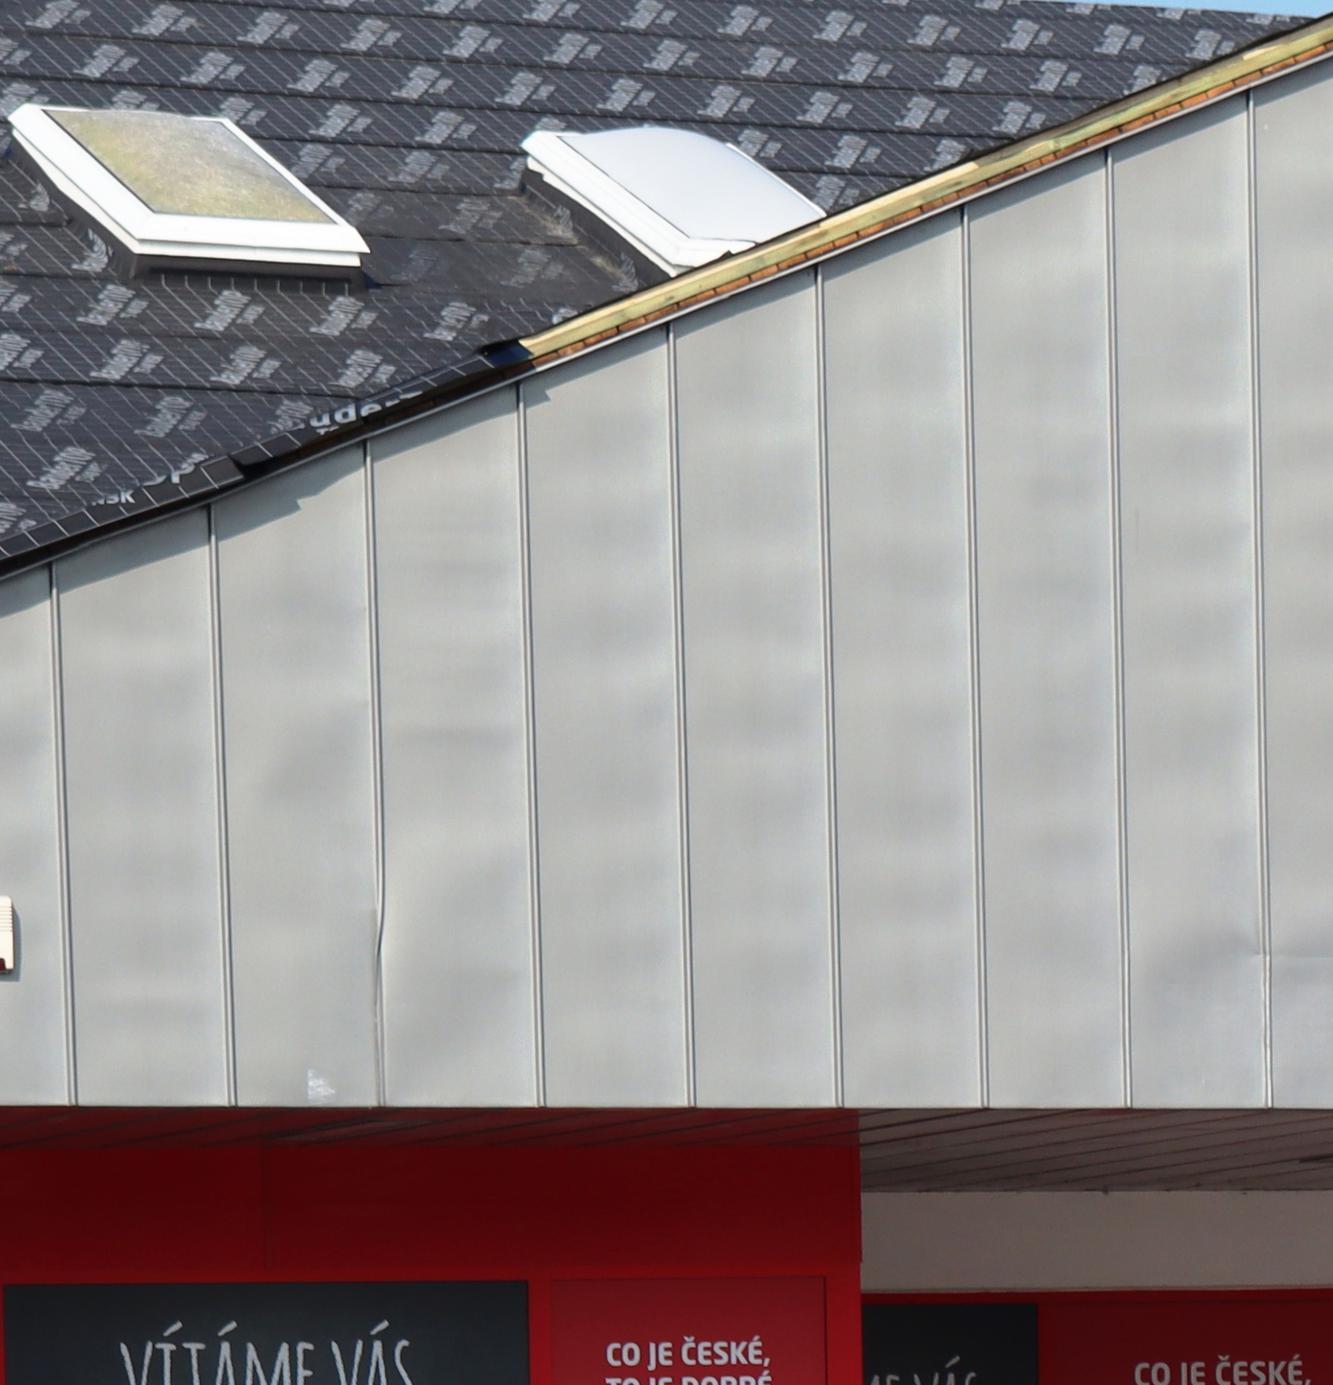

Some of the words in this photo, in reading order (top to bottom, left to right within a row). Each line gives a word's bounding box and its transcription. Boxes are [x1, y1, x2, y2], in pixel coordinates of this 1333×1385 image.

[606, 1341, 643, 1367] CO
[647, 1340, 675, 1371] JE
[680, 1335, 771, 1370] ČESKÉ,
